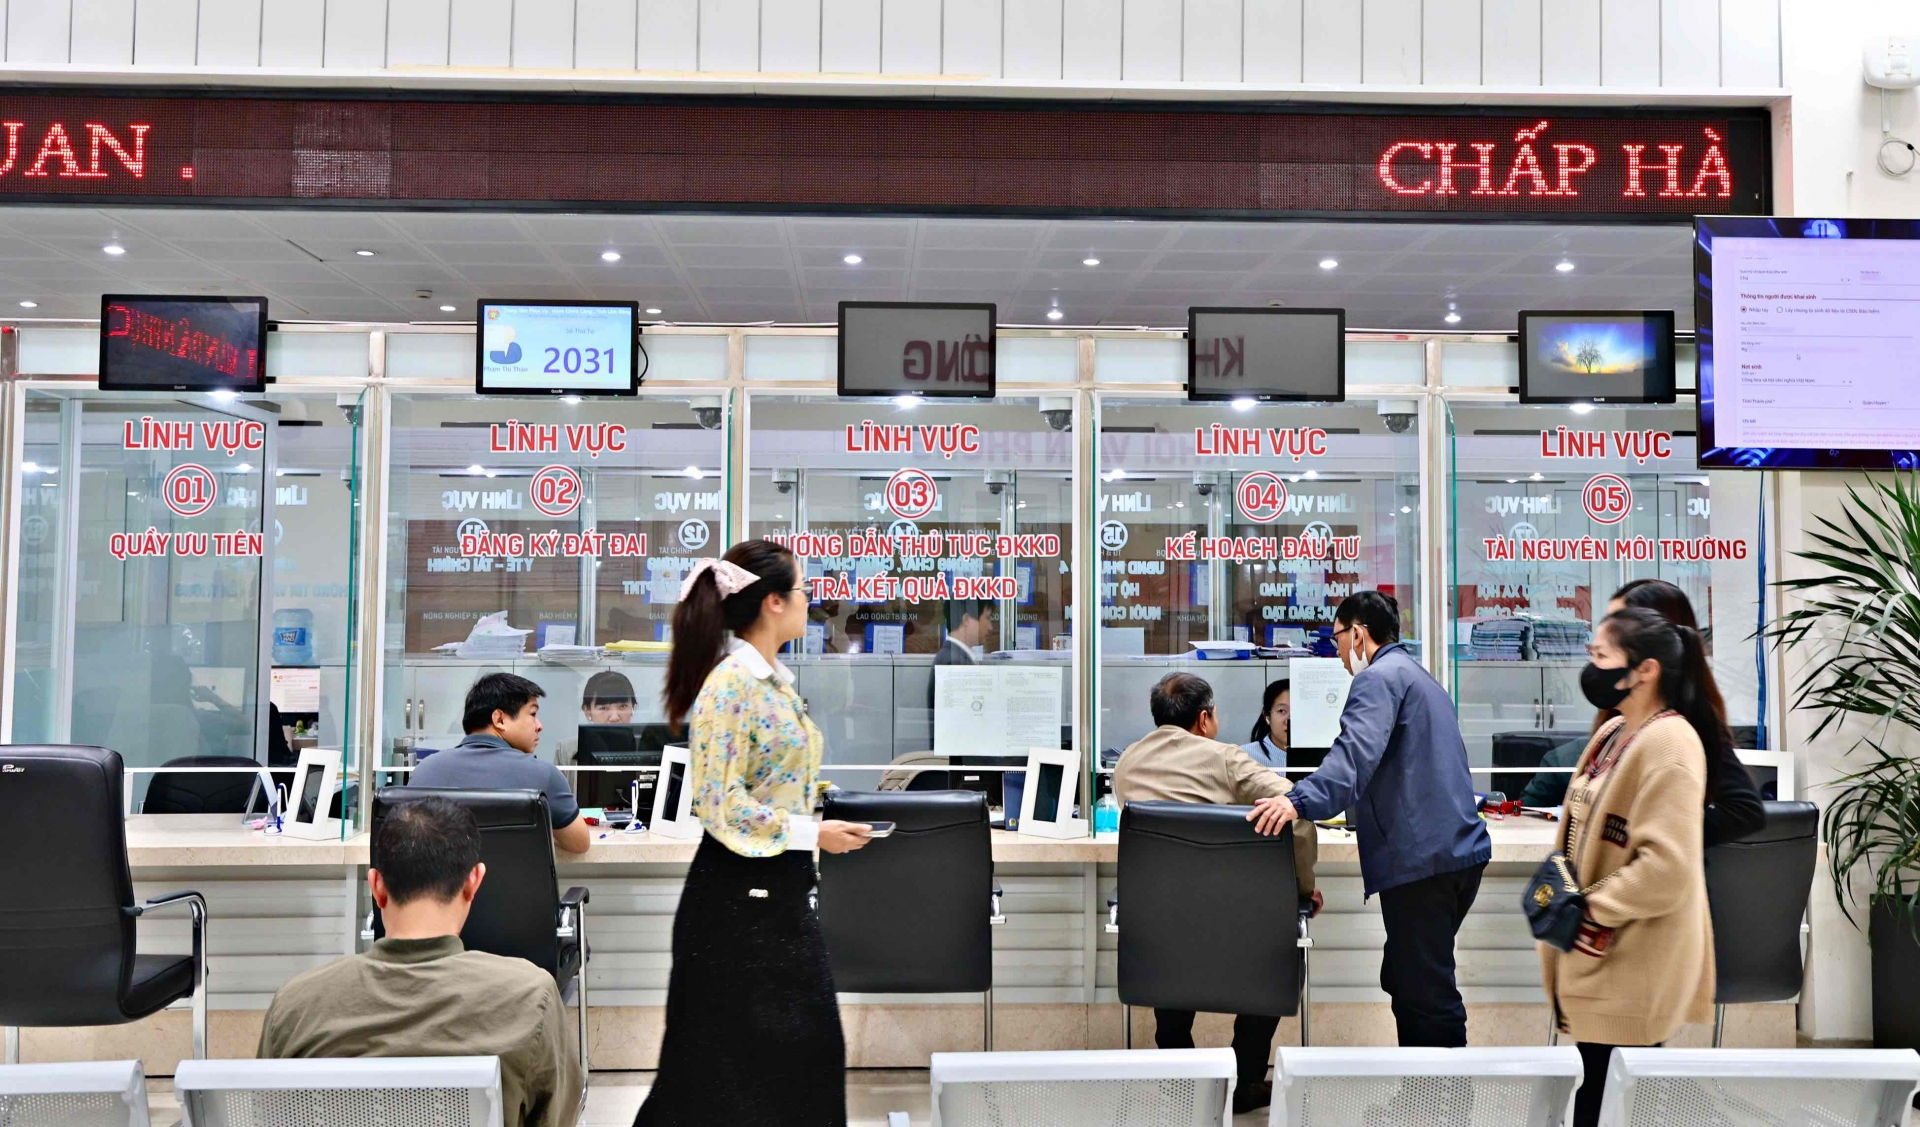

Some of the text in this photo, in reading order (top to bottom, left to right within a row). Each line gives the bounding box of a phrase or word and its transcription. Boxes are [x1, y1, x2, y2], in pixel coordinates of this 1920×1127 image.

[1376, 120, 1732, 198] CHẤP HÀ
[543, 346, 614, 374] 2031
[123, 416, 264, 457] LĨNH VỰC
[490, 420, 627, 458] LĨNH VỰC
[846, 420, 912, 454] LĨNH
[920, 423, 980, 459] VỰC
[1195, 423, 1328, 463] LĨNH VỰC
[1541, 426, 1672, 465] LĨNH VỰC
[172, 475, 207, 505] 01
[538, 476, 574, 506] 02
[894, 479, 929, 507] 03
[1243, 482, 1279, 512] 04
[1589, 484, 1625, 514] 05
[110, 527, 264, 560] QUẦY ƯU TIÊN
[461, 527, 647, 558] ĐĂNG KÝ ĐẤT ĐAI
[849, 526, 893, 557] DẪN
[898, 529, 942, 557] THỦ
[947, 533, 991, 561] TỤC
[996, 533, 1060, 558] ĐKKD
[1166, 530, 1362, 566] KẾ HOẠCH ĐẦU TƯ
[1483, 535, 1747, 561] TÀI NGUYÊN MÔI TRƯỜNG
[809, 570, 1017, 604] TRẢ KẾT QUẢ ĐKKD
